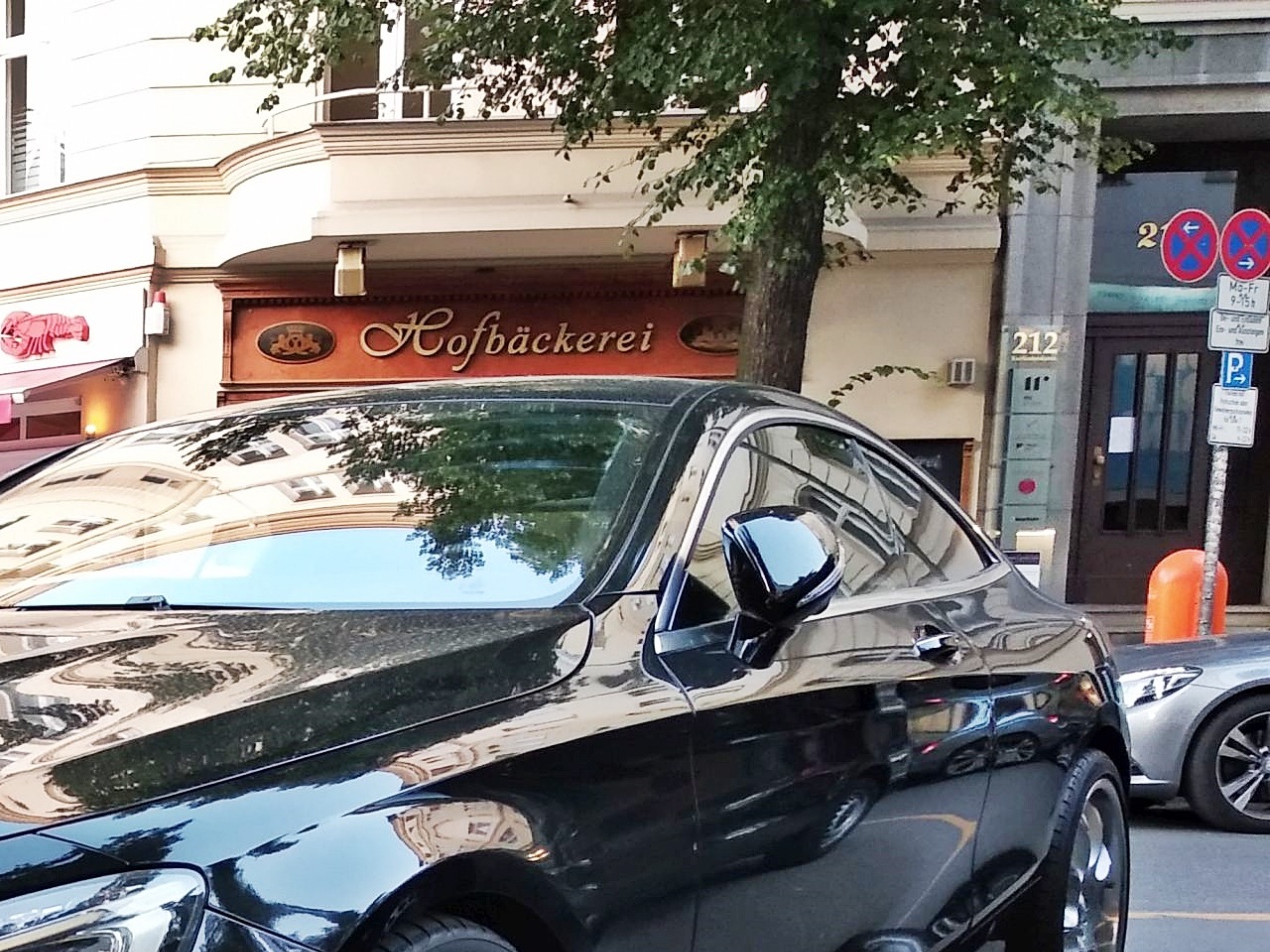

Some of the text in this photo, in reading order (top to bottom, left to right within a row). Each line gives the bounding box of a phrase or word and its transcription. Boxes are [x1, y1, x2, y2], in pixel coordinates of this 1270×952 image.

[1229, 281, 1259, 294] Mo-Fr
[359, 307, 655, 372] Hofbäckerei
[1011, 331, 1058, 355] 212
[1226, 353, 1244, 384] P
